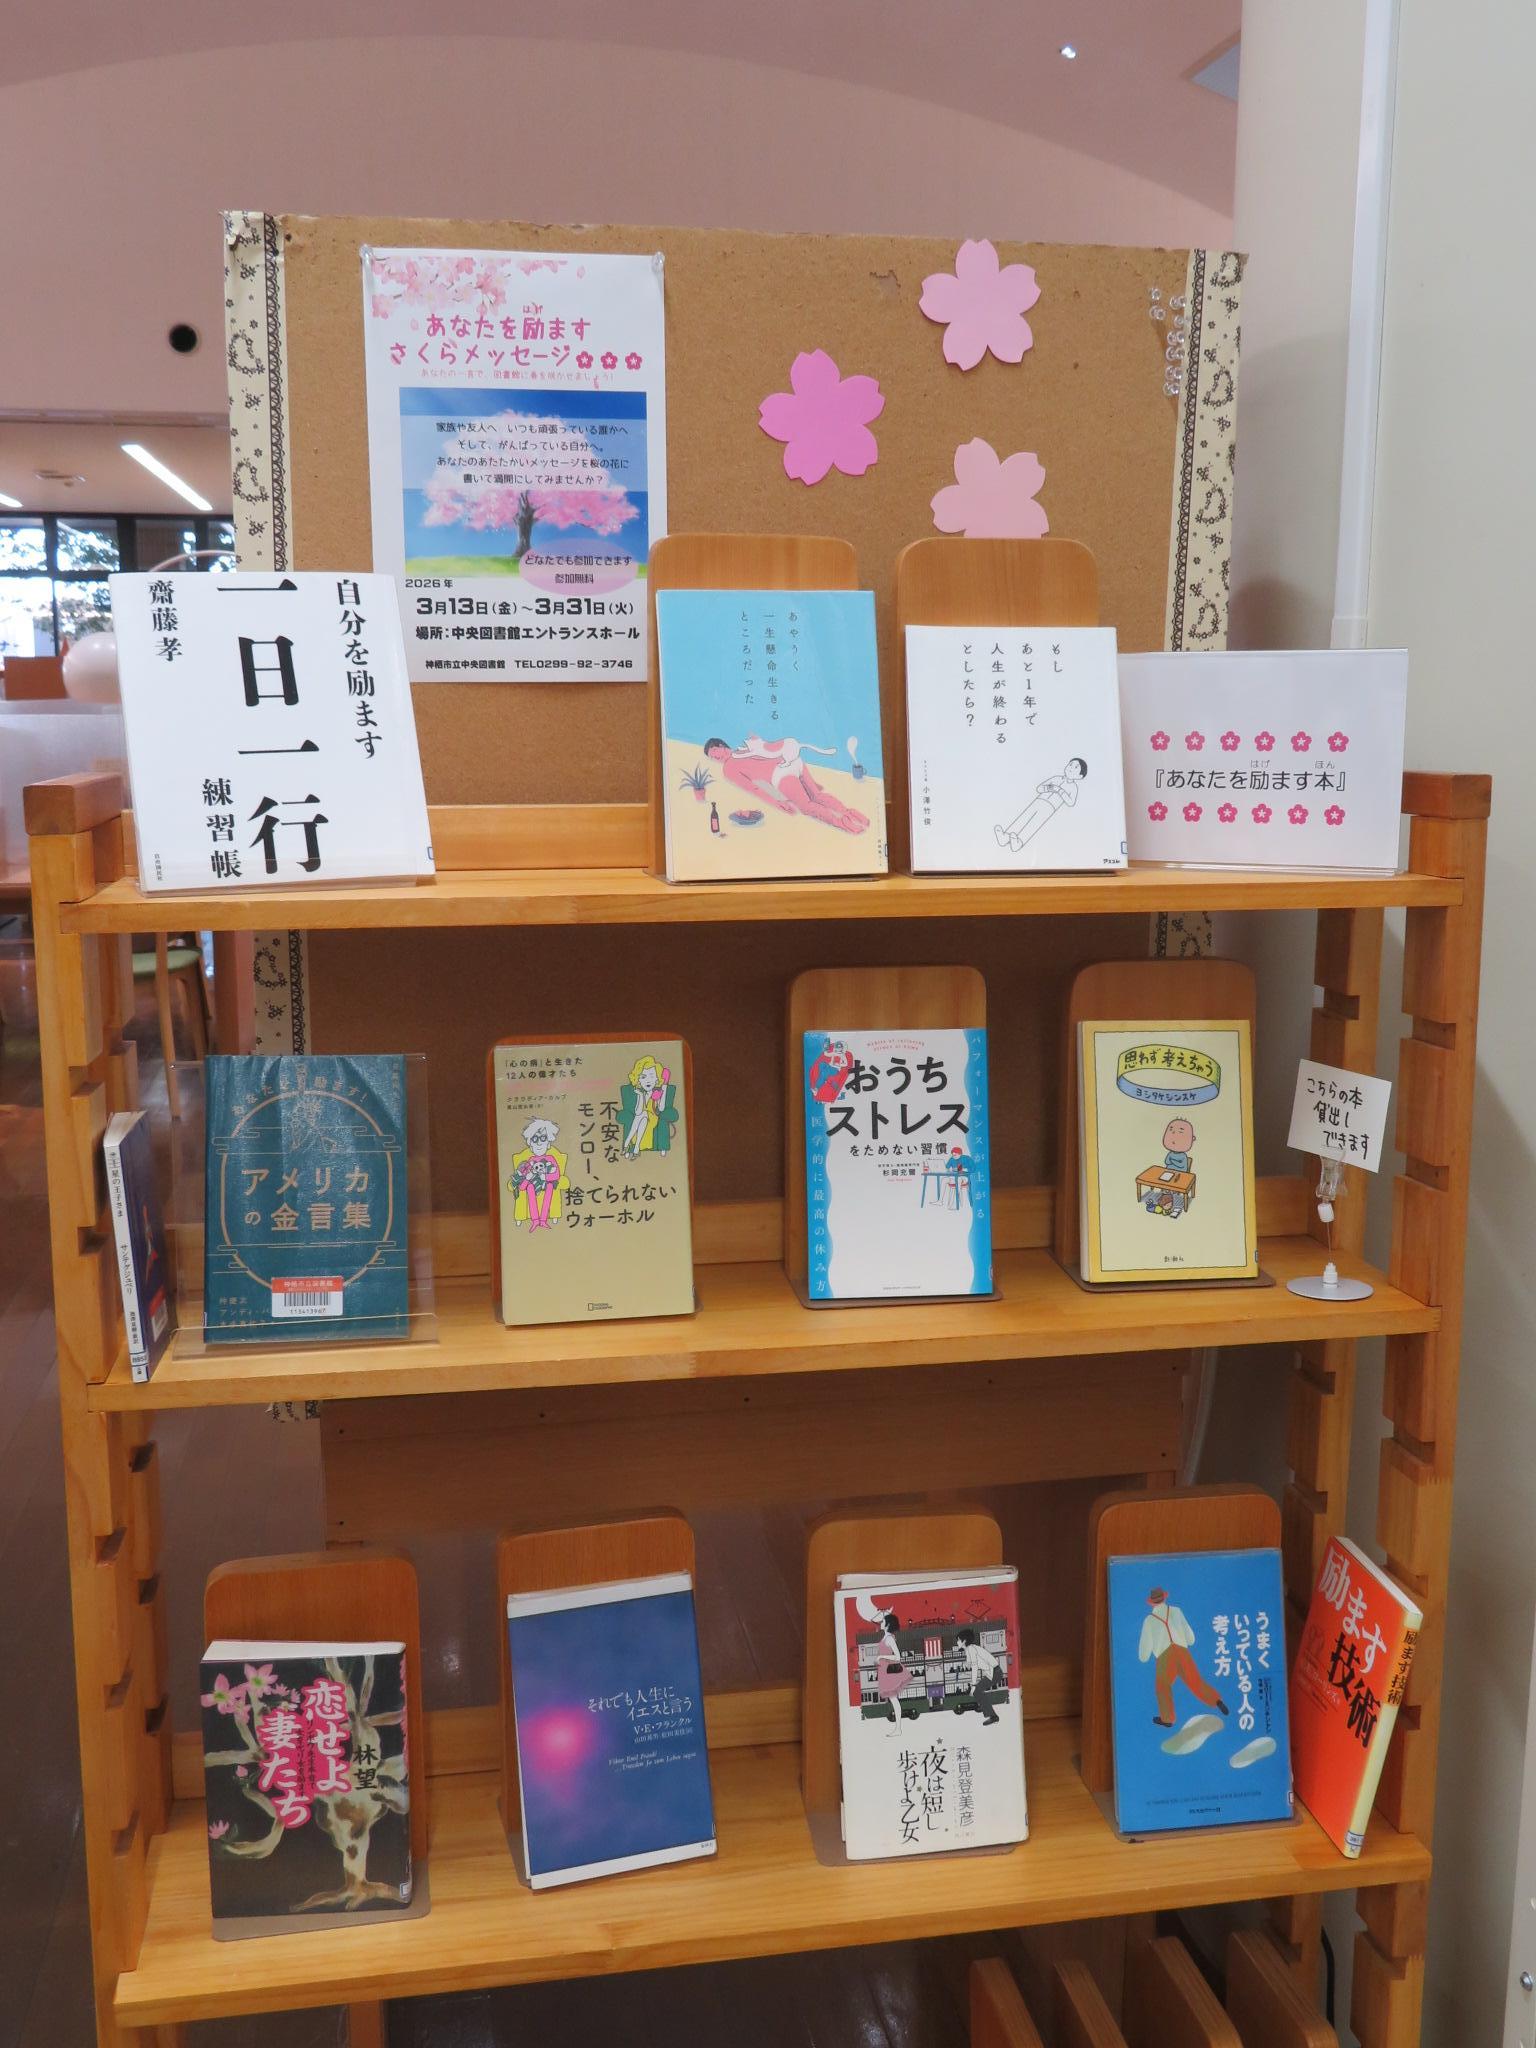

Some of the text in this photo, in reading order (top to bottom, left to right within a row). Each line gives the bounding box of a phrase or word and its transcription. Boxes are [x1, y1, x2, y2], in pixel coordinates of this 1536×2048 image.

[426, 314, 591, 341] あなたを励ます
[390, 341, 570, 366] さくらメッセージ
[436, 421, 629, 436] 家族や友人へ いつも頑張っている誰かへ
[457, 439, 604, 452] そして、がんばっている自分へ。
[436, 456, 630, 470] あなたのあたたかいメッセージを桜の花に
[463, 473, 603, 486] 書いて満開にしてみませんか？
[524, 554, 632, 567] どなたでも参加できます
[554, 572, 594, 585] 参加無料
[415, 626, 640, 642] 場所：中央図書館エントランスホール
[788, 611, 799, 672] あやうく
[336, 578, 383, 760] 自分を励ます
[425, 660, 506, 670] 神栖市立中央図書館
[740, 610, 754, 705] ところだった
[763, 614, 779, 721] 一生懸命生きる
[1052, 643, 1063, 673] もし
[963, 644, 975, 727] としたら？
[991, 642, 1007, 744] 人生が終わる
[1022, 643, 1038, 726] あと1年で
[216, 578, 329, 875] 一日一行
[1155, 768, 1346, 792] 『あなたを励ます本』
[1250, 760, 1335, 770] はげ ほん
[202, 777, 244, 879] 練習帳
[845, 1056, 948, 1095] おうち
[1136, 1088, 1198, 1101] ヨシタケシンスケ
[1306, 1077, 1363, 1109] こちらの本
[599, 1101, 621, 1163] 不安な
[826, 1101, 970, 1140] ストレス
[1314, 1103, 1350, 1127] 貸出し
[577, 1102, 599, 1181] モンロー、
[850, 1142, 950, 1157] をためない習慣
[1323, 1130, 1370, 1160] できます
[242, 1166, 370, 1196] アメリカ
[565, 1184, 677, 1206] 捨てられない
[811, 1100, 827, 1293] 医学的に最高の休み方
[244, 1202, 372, 1232] の金言集
[566, 1208, 655, 1229] ウォーホル
[1318, 1546, 1387, 1674] 励ます
[1212, 1614, 1232, 1677] 考え方
[1255, 1611, 1271, 1670] うまく
[1234, 1614, 1255, 1732] いっている人の
[1387, 1630, 1418, 1705] 励ます技術
[587, 1686, 675, 1713] それでも人生に
[1327, 1632, 1381, 1748] 技術
[626, 1698, 692, 1722] イエスと言う
[304, 1681, 349, 1791] 恋せよ
[260, 1710, 310, 1825] 妻たち
[353, 1744, 378, 1790] 林望
[956, 1746, 975, 1827] 森見登美彦
[898, 1750, 920, 1844] 歩けよ乙女
[921, 1744, 948, 1831] 夜は短し
